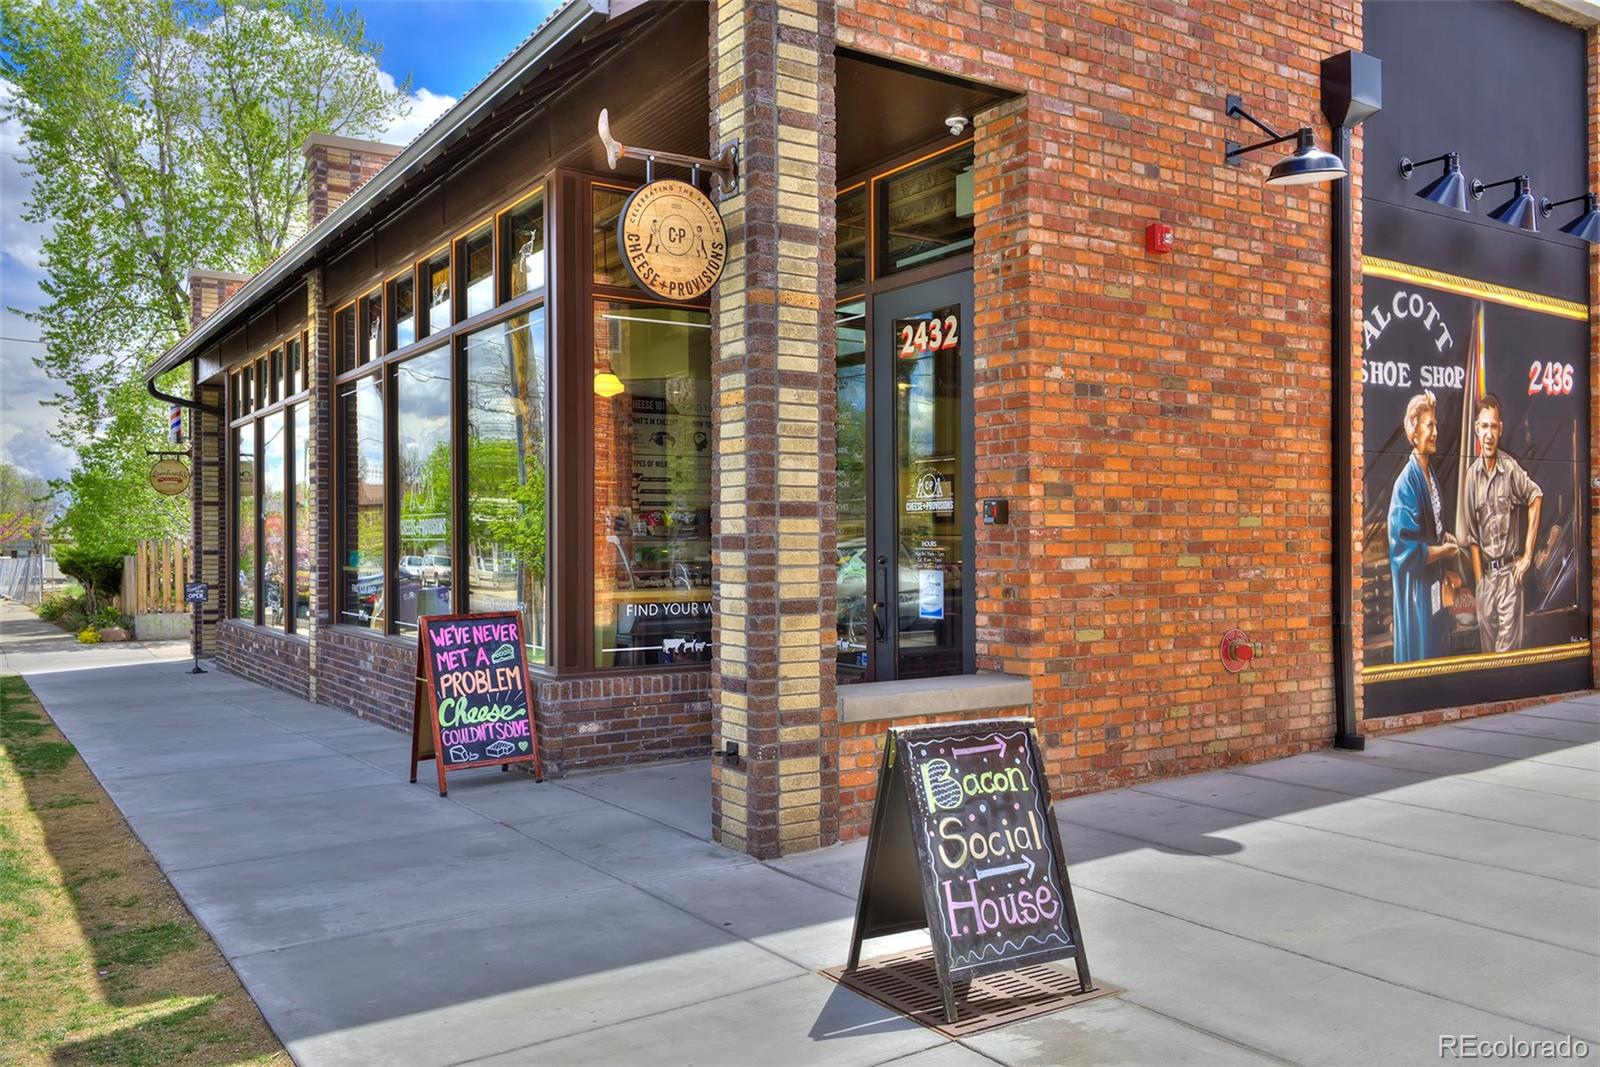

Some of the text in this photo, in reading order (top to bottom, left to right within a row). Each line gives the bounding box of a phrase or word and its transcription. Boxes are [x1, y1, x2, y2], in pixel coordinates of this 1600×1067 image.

[630, 184, 721, 233] CELEBRATING THE ARTISAN
[898, 314, 959, 359] 2432
[1362, 290, 1453, 352] ALCOTT
[1420, 364, 1466, 389] SHOP
[1528, 360, 1574, 396] 2436
[632, 399, 654, 410] HEESE
[625, 602, 714, 617] FIND YOUR W
[430, 623, 519, 647] WE'VE NEVER
[436, 647, 490, 671] MET A
[440, 665, 522, 698] PROBLEM
[438, 695, 526, 727] Cheese
[442, 719, 530, 746] COULDN'T SOLVE
[920, 758, 1029, 814] Bacon
[938, 810, 1042, 869] Social
[942, 878, 1060, 938] House
